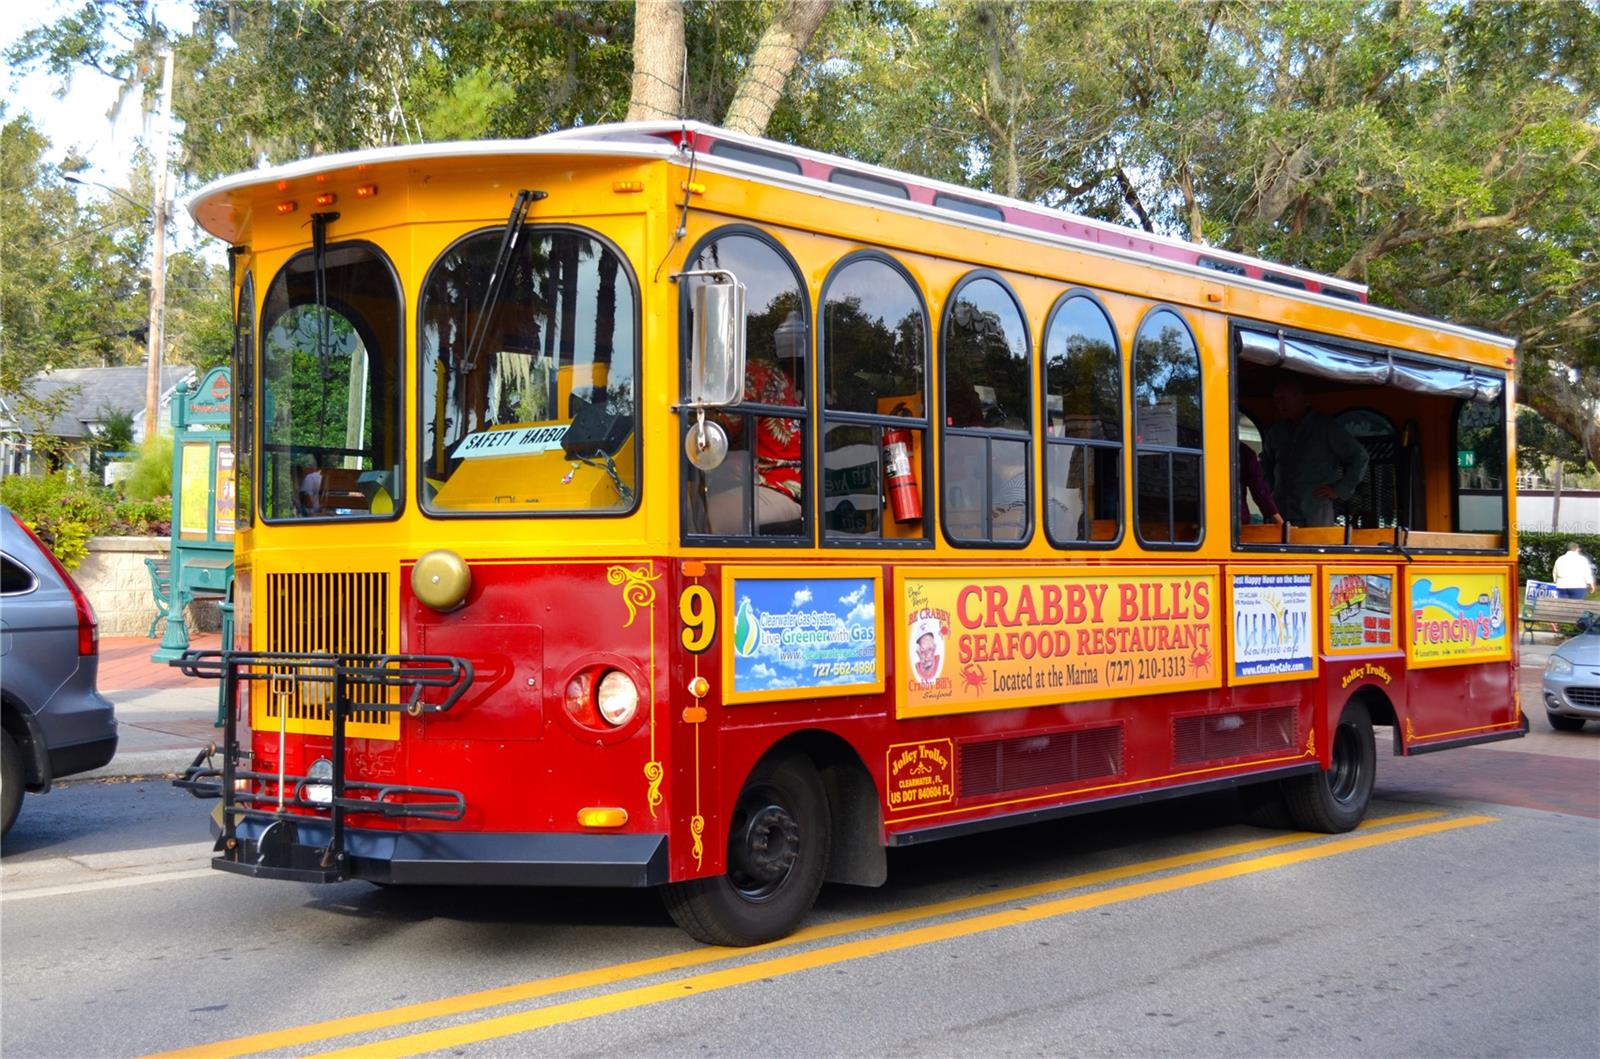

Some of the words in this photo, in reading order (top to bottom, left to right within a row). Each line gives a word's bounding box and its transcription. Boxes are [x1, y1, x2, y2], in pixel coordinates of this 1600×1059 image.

[465, 430, 518, 450] SAFETY
[519, 427, 570, 445] HARBO
[1465, 454, 1473, 466] N
[908, 611, 919, 626] BE
[920, 607, 951, 624] CRABBY
[956, 583, 1108, 630] CRABBY
[1118, 580, 1210, 622] BILL'S
[679, 584, 716, 654] 9
[761, 612, 797, 626] Clearwater
[798, 612, 811, 626] Gas
[811, 611, 836, 628] System
[1412, 610, 1491, 647] Frenchy's
[761, 631, 780, 645] Live
[783, 629, 829, 644] Greener
[829, 629, 849, 642] with
[851, 626, 874, 641] Gas
[958, 630, 1071, 664] SEAFOOD
[1075, 623, 1210, 656] RESTAURANT
[908, 680, 934, 692] Crabby
[993, 668, 1032, 693] Located
[1035, 670, 1045, 688] at
[1047, 665, 1063, 688] the
[1066, 662, 1098, 686] Marina
[1105, 658, 1134, 688] (727)
[1138, 655, 1186, 680] 210-1313
[1341, 668, 1364, 688] Jolley
[1365, 663, 1392, 685] Trolley
[892, 750, 918, 775] Jolley
[918, 745, 948, 770] Trolley
[890, 791, 901, 804] US
[902, 789, 917, 802] DOT
[942, 784, 950, 796] FL
